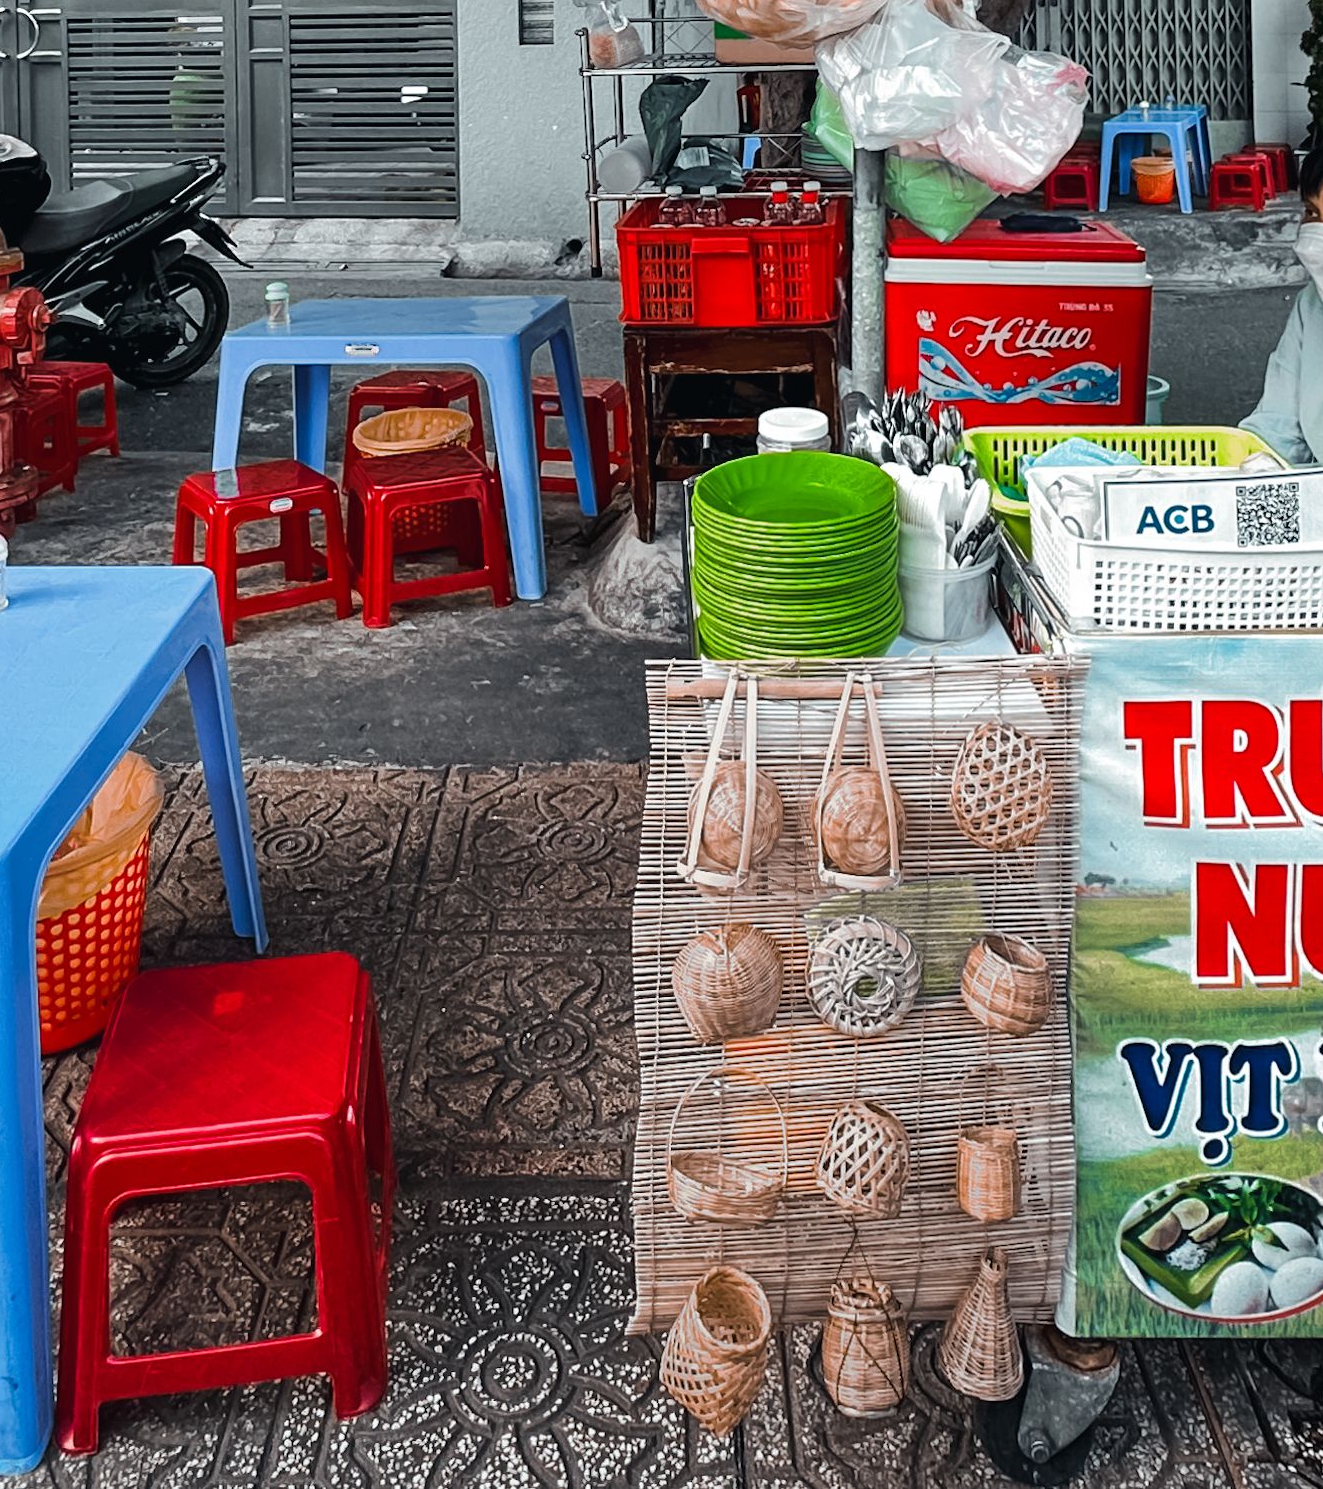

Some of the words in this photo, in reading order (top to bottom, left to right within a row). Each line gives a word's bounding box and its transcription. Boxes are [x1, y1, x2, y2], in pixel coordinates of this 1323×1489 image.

[948, 315, 1092, 358] Hitaco
[1136, 503, 1216, 537] ACB
[1118, 1034, 1300, 1166] VỊT
